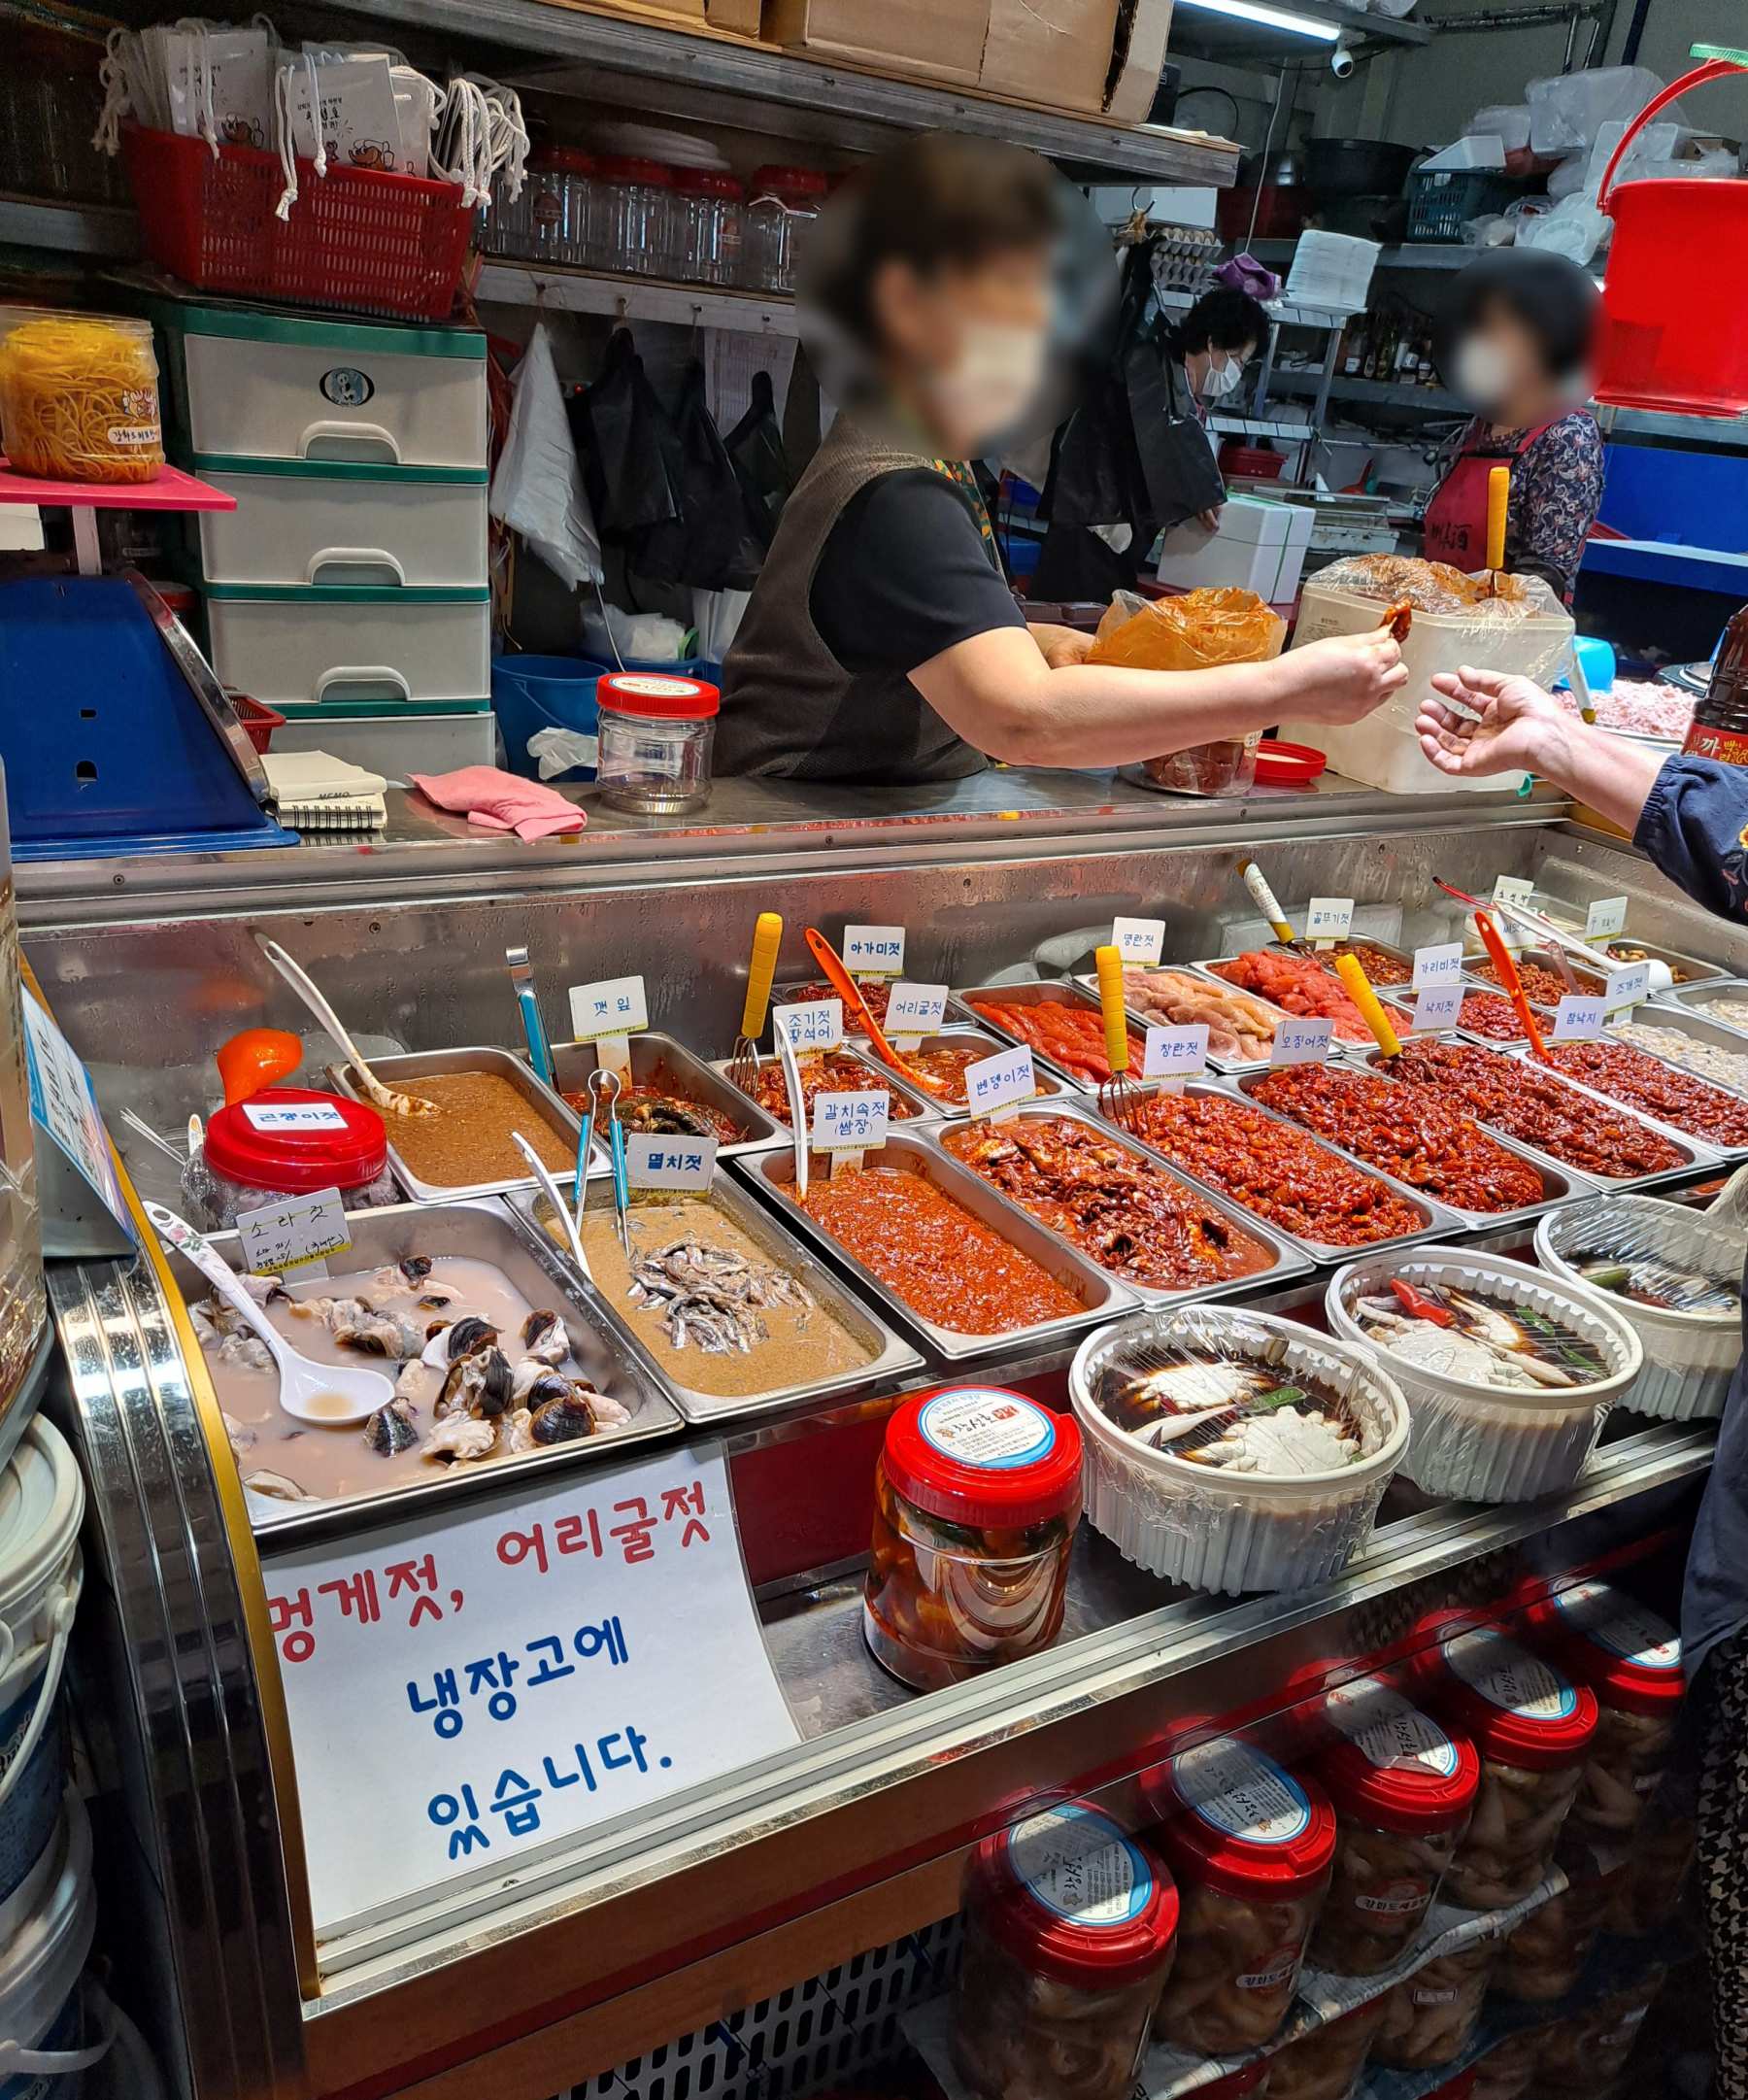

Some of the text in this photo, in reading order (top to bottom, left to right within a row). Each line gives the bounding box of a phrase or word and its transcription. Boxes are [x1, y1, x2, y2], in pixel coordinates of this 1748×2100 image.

[319, 791, 351, 800] MEMO
[851, 941, 900, 956] 아가미젓
[1123, 933, 1155, 948] 명란젓
[895, 1000, 942, 1016] 어리굴젓
[1426, 1000, 1455, 1014] 낙지젓
[789, 1009, 830, 1028] 조기젓
[1566, 1011, 1597, 1025] 참낙지
[1160, 1040, 1198, 1058] 창란젓
[1281, 1035, 1328, 1049] 오징어젓
[824, 1101, 886, 1120] 갈치속젓
[834, 1118, 873, 1135] (쌈장)
[648, 1152, 702, 1171] 멸치젓
[268, 1480, 715, 1663] 멍게젓, 어리굴젓
[407, 1615, 630, 1741] 냉장고에
[427, 1724, 673, 1861] 있습니다.
